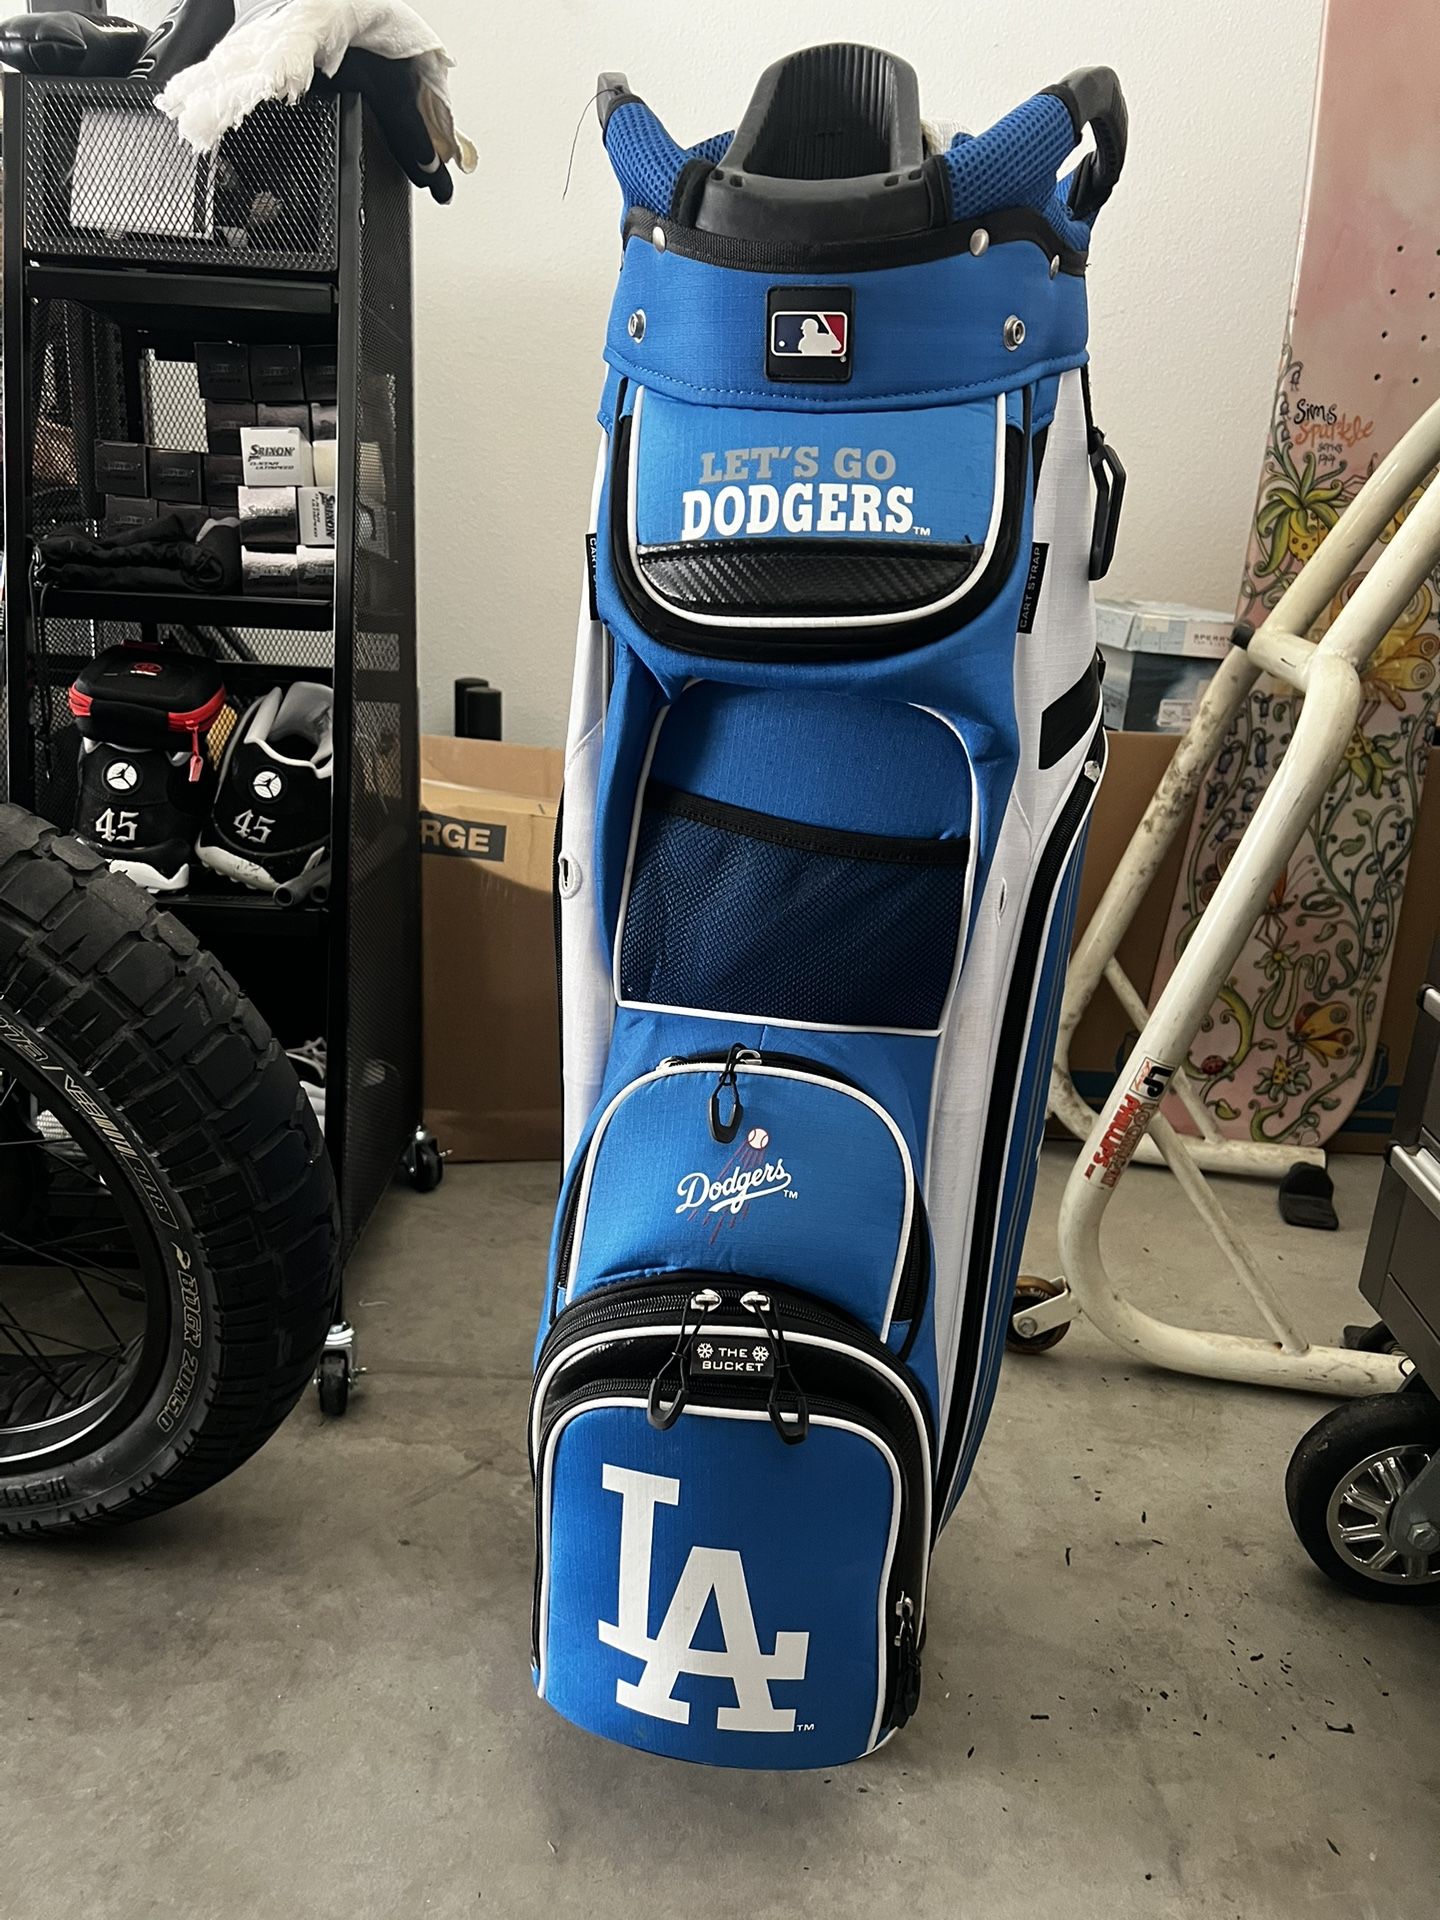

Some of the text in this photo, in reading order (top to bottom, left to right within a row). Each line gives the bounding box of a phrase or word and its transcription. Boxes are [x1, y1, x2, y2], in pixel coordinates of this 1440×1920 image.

[1294, 398, 1338, 425] Sims
[699, 446, 897, 484] LET'S GO
[681, 482, 914, 541] DODGERS
[1020, 547, 1041, 628] CART STRAP
[95, 808, 140, 842] 45
[233, 809, 276, 843] 45
[675, 1158, 792, 1214] Dodgers
[702, 1360, 764, 1372] BUCKET
[718, 1347, 748, 1358] THE
[598, 1463, 810, 1732] LA
